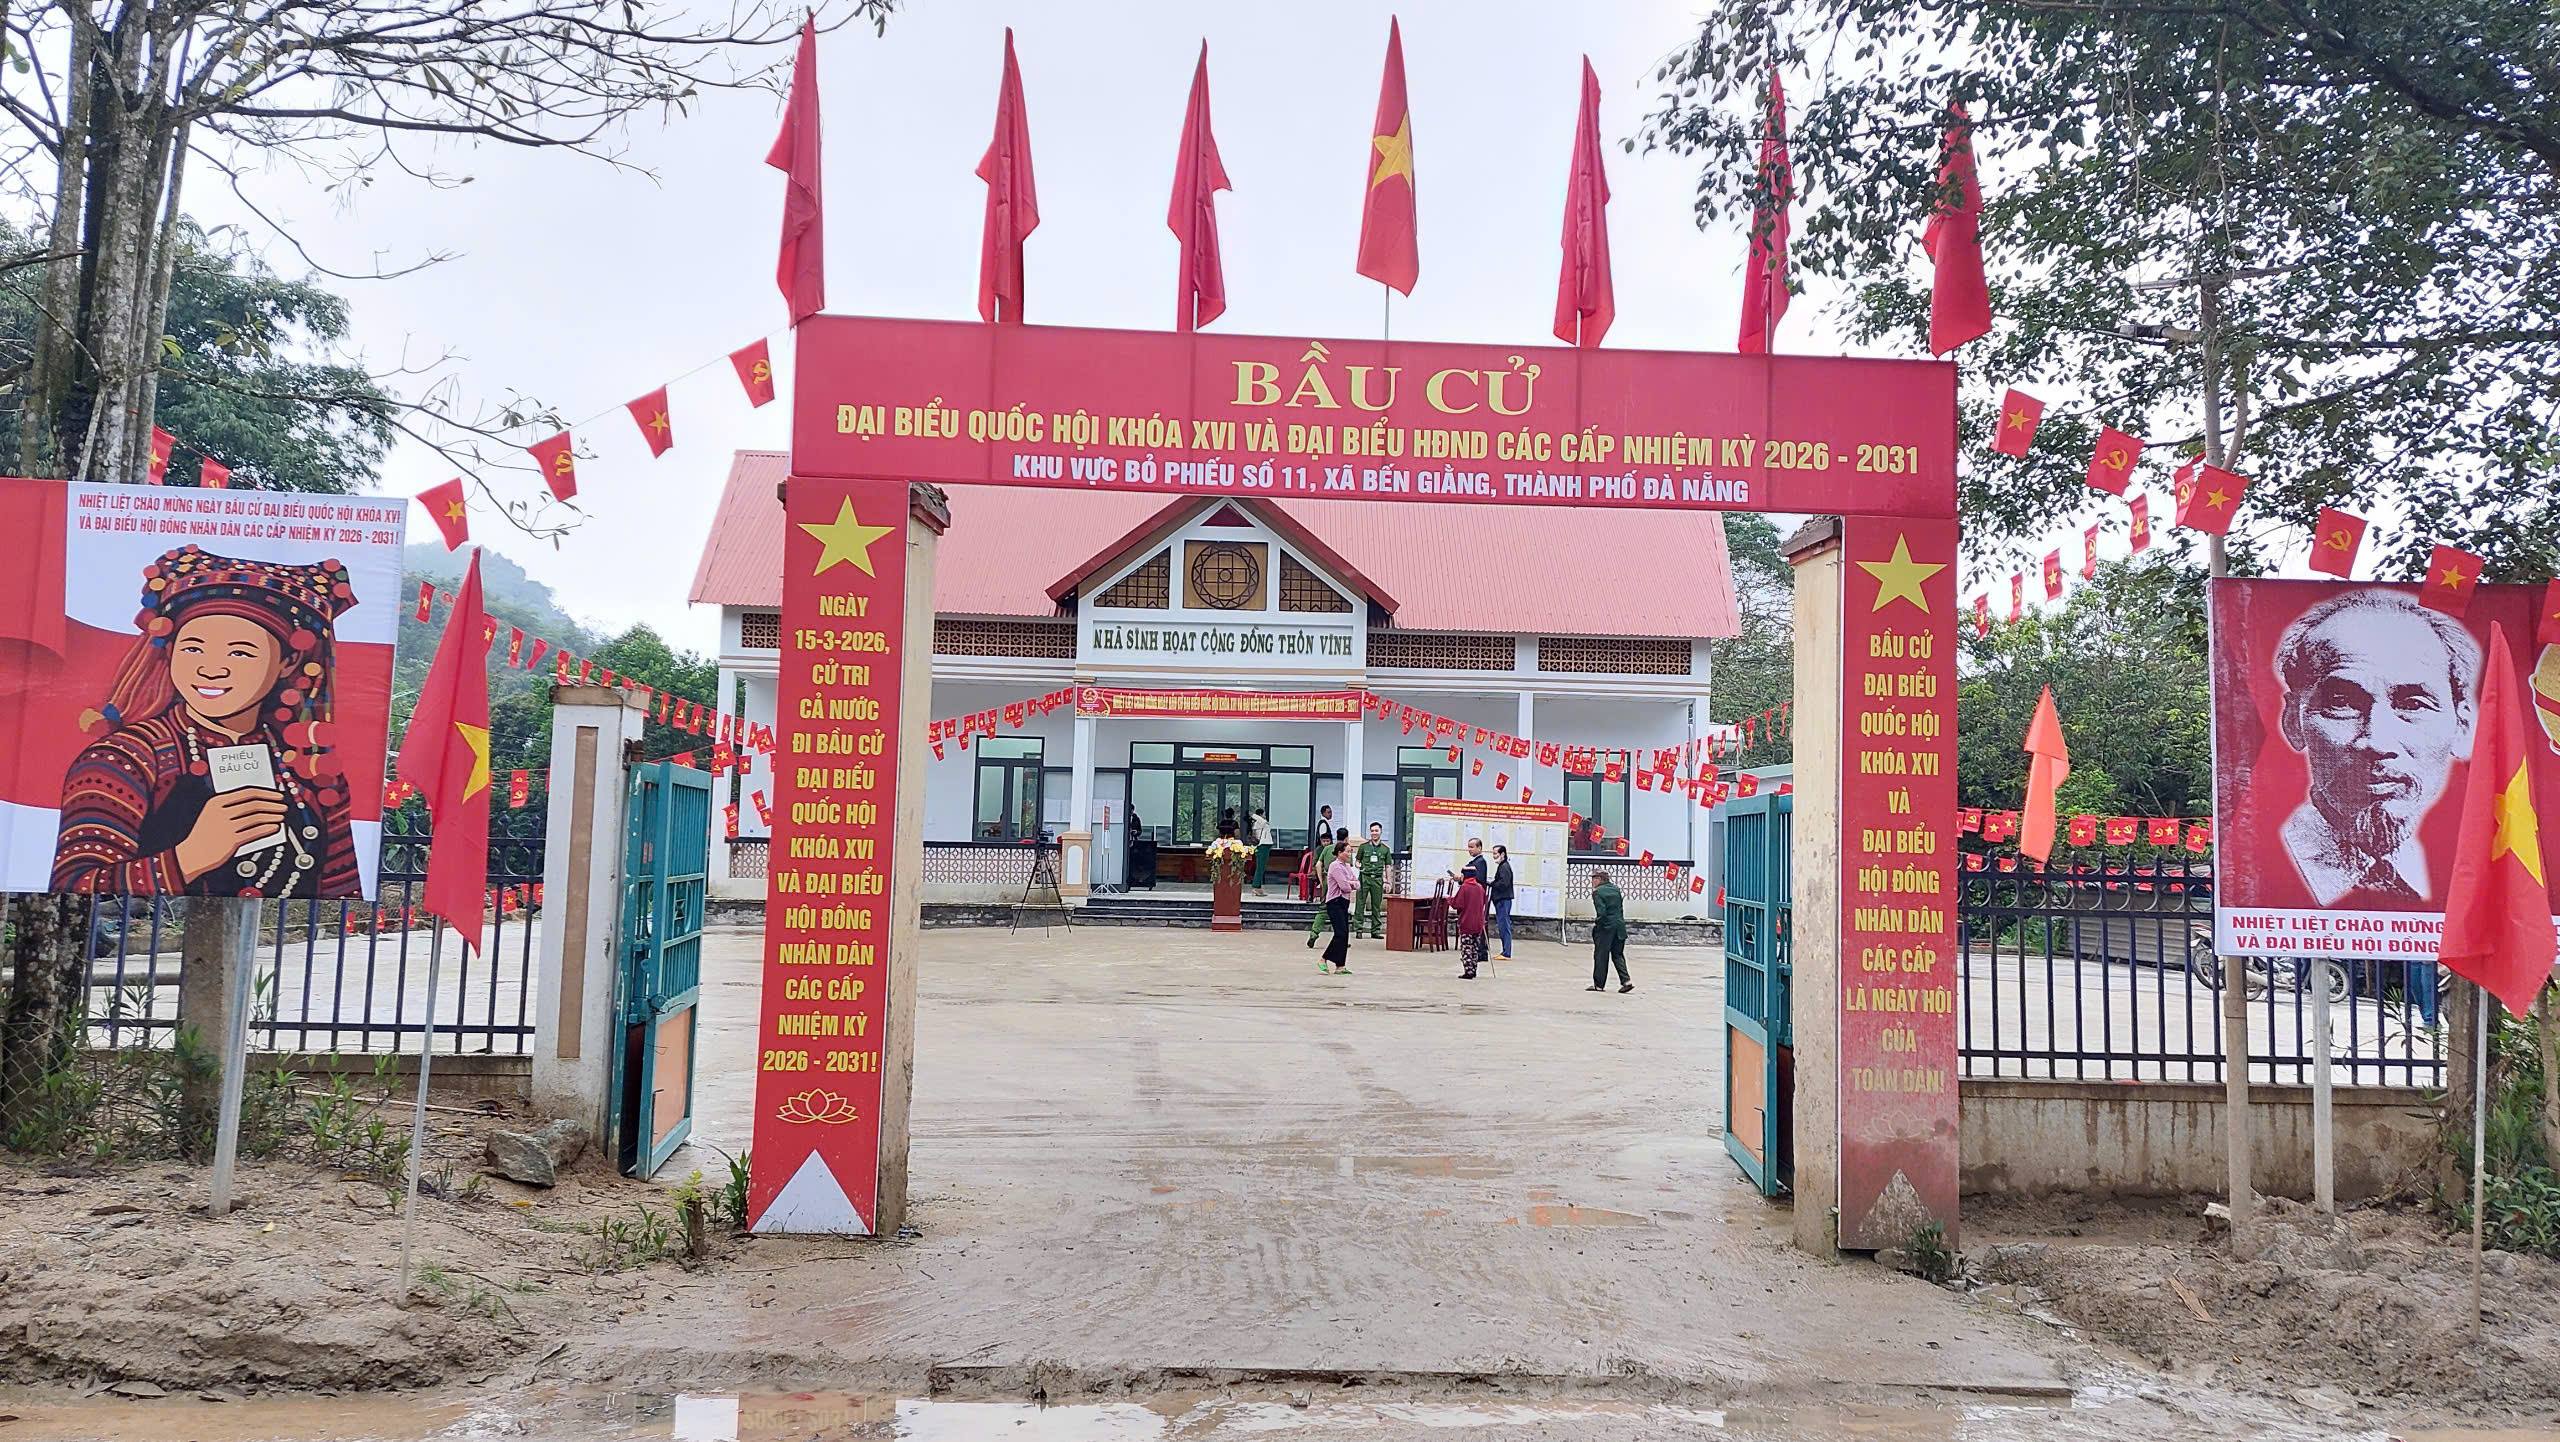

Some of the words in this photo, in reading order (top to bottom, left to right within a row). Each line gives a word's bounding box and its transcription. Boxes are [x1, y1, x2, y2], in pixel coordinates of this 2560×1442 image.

[1230, 341, 1402, 411] BẦU
[1426, 355, 1541, 416] CỬ
[837, 404, 885, 441] ĐẠI
[894, 397, 960, 438] BIỂU
[968, 402, 1044, 443] QUỐC
[1053, 409, 1099, 451] HỘI
[1108, 412, 1183, 449] KHÓA
[1191, 420, 1236, 451] XVI
[1245, 417, 1280, 452] VÀ
[1288, 424, 1333, 461] ĐẠI
[1343, 416, 1405, 457] BIỂU
[1414, 429, 1487, 460] HĐND
[1497, 426, 1552, 462] CÁC
[1560, 424, 1615, 466] CẤP
[1624, 431, 1713, 472] NHIỆM
[1721, 434, 1755, 468] KỲ
[1764, 441, 1829, 471] 2026
[1857, 445, 1918, 474] 2031
[1013, 455, 1063, 479] KHU
[1071, 456, 1118, 486] VỰC
[1125, 454, 1157, 484] BỎ
[1164, 457, 1235, 486] PHIẾU
[1242, 458, 1274, 488] SỐ
[1282, 466, 1317, 492] 11,
[1323, 464, 1356, 491] XÃ
[1363, 464, 1409, 493] BẾN
[1417, 464, 1497, 498] GIẰNG,
[1504, 469, 1582, 497] THÀNH
[1589, 470, 1637, 499] PHỐ
[1643, 476, 1674, 501] ĐÀ
[1683, 472, 1749, 503] NẴNG
[79, 492, 108, 511] NHIỆT
[111, 493, 131, 512] LIỆT
[133, 494, 160, 511] CHÀO
[163, 495, 192, 512] MỪNG
[195, 497, 222, 514] NGÀY
[225, 496, 245, 515] BẦU
[248, 497, 262, 516] CỬ
[264, 503, 280, 520] ĐẠI
[283, 499, 305, 518] BIỂU
[308, 502, 334, 520] QUỐC
[337, 505, 353, 524] HỘI
[356, 506, 382, 521] KHÓA
[384, 509, 401, 524] XVI
[80, 513, 92, 529] VÀ
[95, 516, 112, 533] ĐẠI
[114, 512, 137, 531] BIỂU
[140, 516, 157, 535] HỘI
[160, 515, 187, 534] ĐỒNG
[190, 519, 217, 535] NHÂN
[220, 520, 240, 536] DÂN
[244, 521, 263, 537] CÁC
[266, 520, 286, 538] CẤP
[289, 524, 320, 543] NHIỆM
[323, 525, 336, 541] KỲ
[339, 529, 362, 543] 2026
[371, 530, 399, 545] 2031!
[819, 593, 869, 617] NGÀY
[795, 630, 890, 655] 15-3-2026,
[1093, 625, 1123, 649] NHÀ
[1200, 626, 1235, 655] CỘNG
[1240, 625, 1273, 653] ĐỒNG
[1278, 629, 1314, 655] THÔN
[1870, 627, 1904, 658] BẦU
[1909, 629, 1933, 659] CỬ
[812, 659, 839, 686] CỬ
[842, 665, 870, 686] TRI
[1864, 673, 1892, 701] ĐẠI
[1898, 666, 1937, 698] BIỂU
[799, 692, 825, 719] CẢ
[829, 696, 880, 721] NƯỚC
[1860, 705, 1906, 737] QUỐC
[1911, 710, 1939, 741] HỘI
[792, 732, 811, 754] ĐI
[816, 726, 853, 755] BẦU
[858, 728, 886, 756] CỬ
[1860, 746, 1906, 775] KHÓA
[1911, 753, 1939, 776] XVI
[796, 767, 828, 793] ĐẠI
[833, 761, 875, 790] BIỂU
[791, 796, 841, 825] QUỐC
[846, 801, 877, 829] HỘI
[1888, 787, 1910, 814] VÀ
[790, 834, 839, 859] KHÓA
[844, 839, 874, 860] XVI
[1863, 829, 1891, 857] ĐẠI
[1897, 822, 1936, 854] BIỂU
[777, 869, 801, 894] VÀ
[805, 873, 836, 898] ĐẠI
[841, 866, 883, 895] BIỂU
[1859, 865, 1887, 898] HỘI
[1892, 863, 1940, 894] ĐỒNG
[785, 904, 816, 933] HỘI
[821, 901, 872, 930] ĐỒNG
[1855, 904, 1903, 932] NHÂN
[1907, 905, 1944, 934] DÂN
[2232, 914, 2286, 932] NHIỆT
[2292, 915, 2329, 933] LIỆT
[2335, 916, 2385, 932] CHÀO
[2391, 917, 2444, 934] MỪNG
[779, 940, 831, 965] NHÂN
[836, 940, 874, 966] DÂN
[1862, 944, 1897, 972] CÁC
[1902, 941, 1936, 973] CẤP
[2236, 933, 2260, 949] VÀ
[2266, 936, 2297, 952] ĐẠI
[2303, 932, 2345, 951] BIỂU
[2352, 936, 2382, 955] HỘI
[2389, 935, 2439, 953] ĐỒNG
[785, 975, 822, 1000] CÁC
[827, 972, 865, 1000] CẤP
[1846, 983, 1867, 1011] LÀ
[1872, 984, 1918, 1012] NGÀY
[1922, 985, 1952, 1018] HỘI
[778, 1011, 838, 1040] NHIỆM
[844, 1012, 868, 1036] KỲ
[1882, 1021, 1917, 1052] CỦA
[763, 1050, 808, 1072] 2026
[825, 1051, 878, 1073] 2031!
